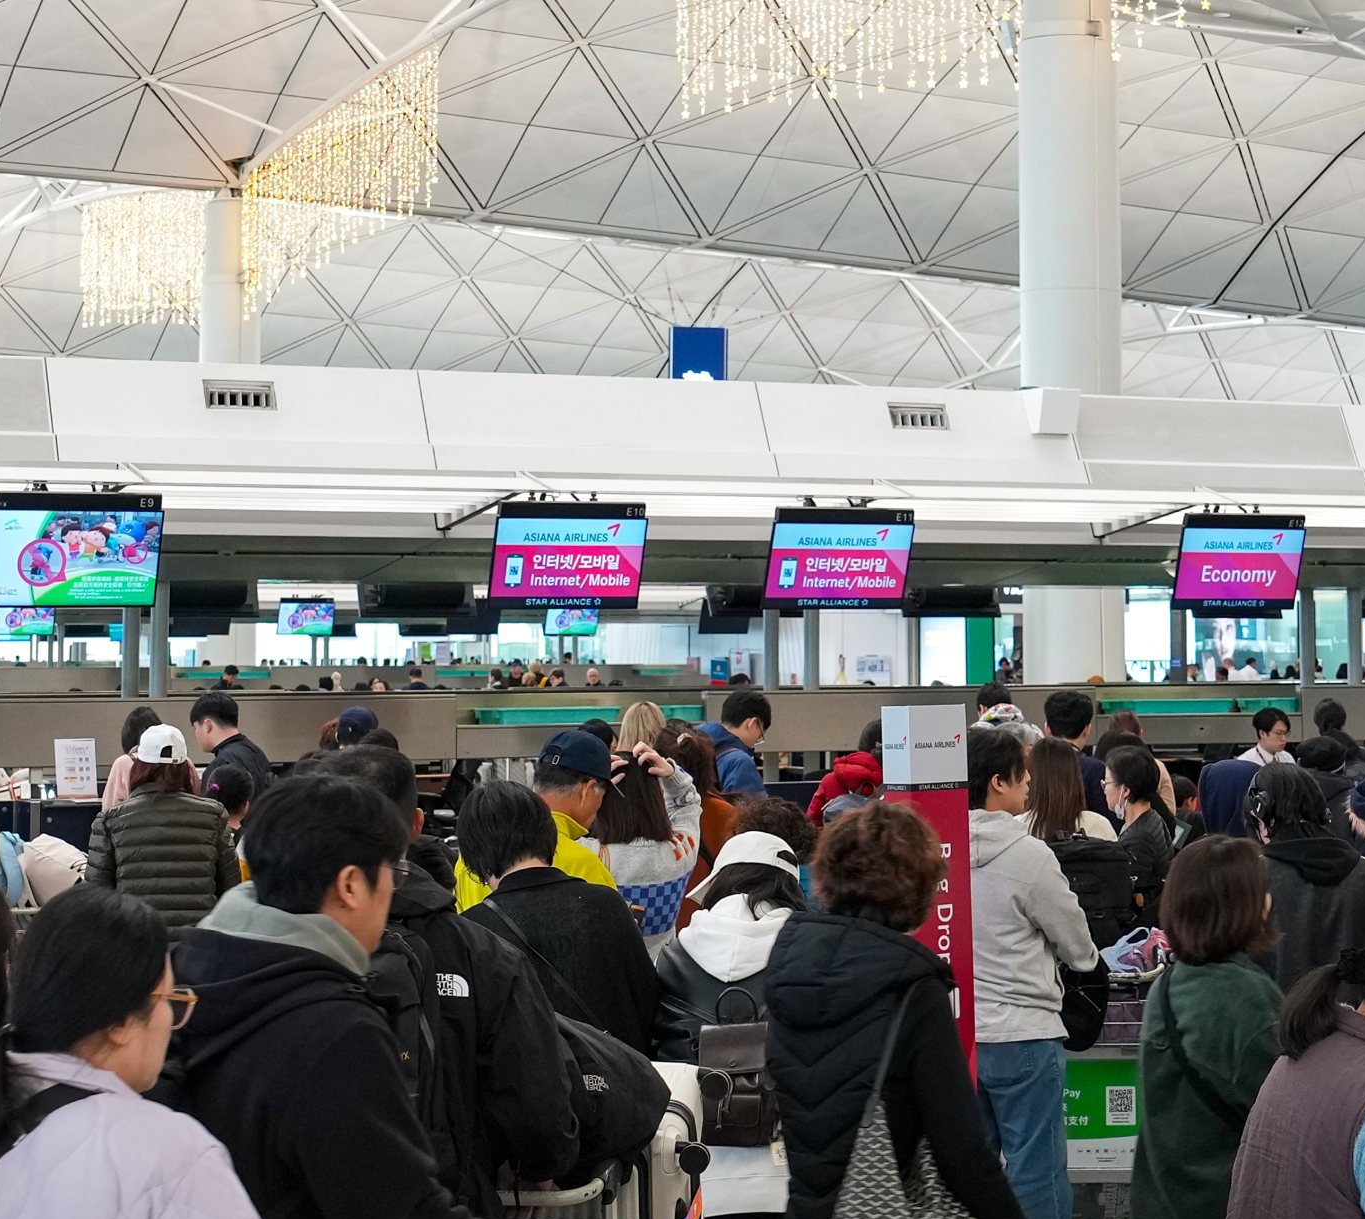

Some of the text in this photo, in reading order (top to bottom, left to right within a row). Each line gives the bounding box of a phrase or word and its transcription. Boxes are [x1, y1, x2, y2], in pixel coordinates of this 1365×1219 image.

[140, 498, 154, 508] E9
[626, 508, 644, 517] E10
[896, 513, 913, 522] E11
[1288, 520, 1304, 528] E12
[524, 532, 608, 542] ASIANA AIRLINES
[798, 537, 877, 546] ASIANA AIRLINES
[1204, 541, 1274, 550] ASIANA AIRLINES
[532, 554, 620, 570] 인터넷/모바일
[806, 557, 888, 573] 인터넷/모바일
[530, 574, 630, 588] Internet/Mobile
[1201, 565, 1277, 587] Economy
[802, 576, 896, 590] Internet/Mobile
[934, 740, 956, 749] AIRLINES
[937, 843, 952, 893] Bg
[436, 973, 453, 981] THE
[1063, 1088, 1081, 1100] Pay
